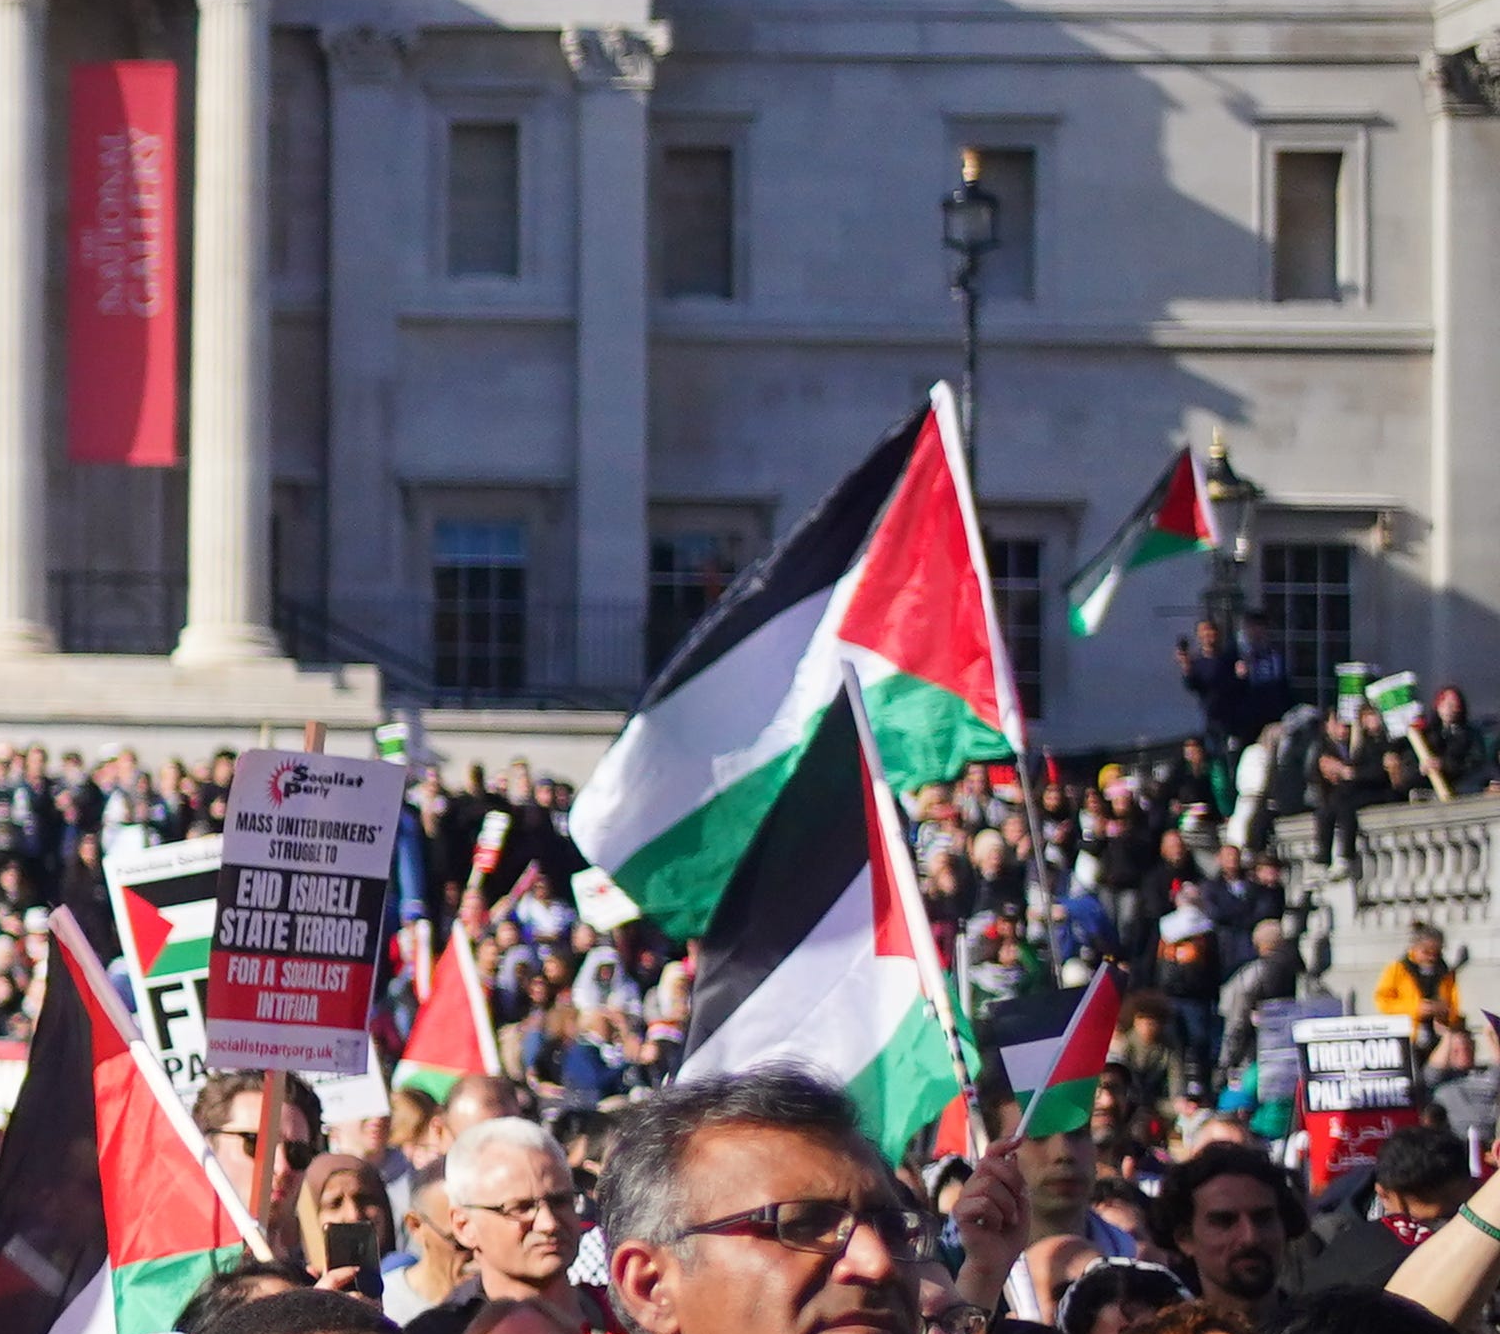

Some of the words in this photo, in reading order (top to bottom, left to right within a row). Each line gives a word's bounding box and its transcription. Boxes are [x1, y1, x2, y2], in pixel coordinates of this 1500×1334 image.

[128, 128, 162, 318] GALLERY
[283, 781, 331, 799] Party
[292, 764, 364, 788] Socialist
[236, 811, 273, 834] MASS
[276, 816, 317, 839] UNITED
[325, 845, 339, 865] TO
[236, 868, 283, 910] END
[288, 873, 362, 917] ISRAELI
[219, 907, 291, 951] STATE
[295, 915, 369, 957] TERROR
[227, 954, 261, 985] FOR
[263, 958, 276, 987] A
[1307, 1038, 1404, 1072] FREEDOM
[1308, 1076, 1411, 1112] PALESTINE
